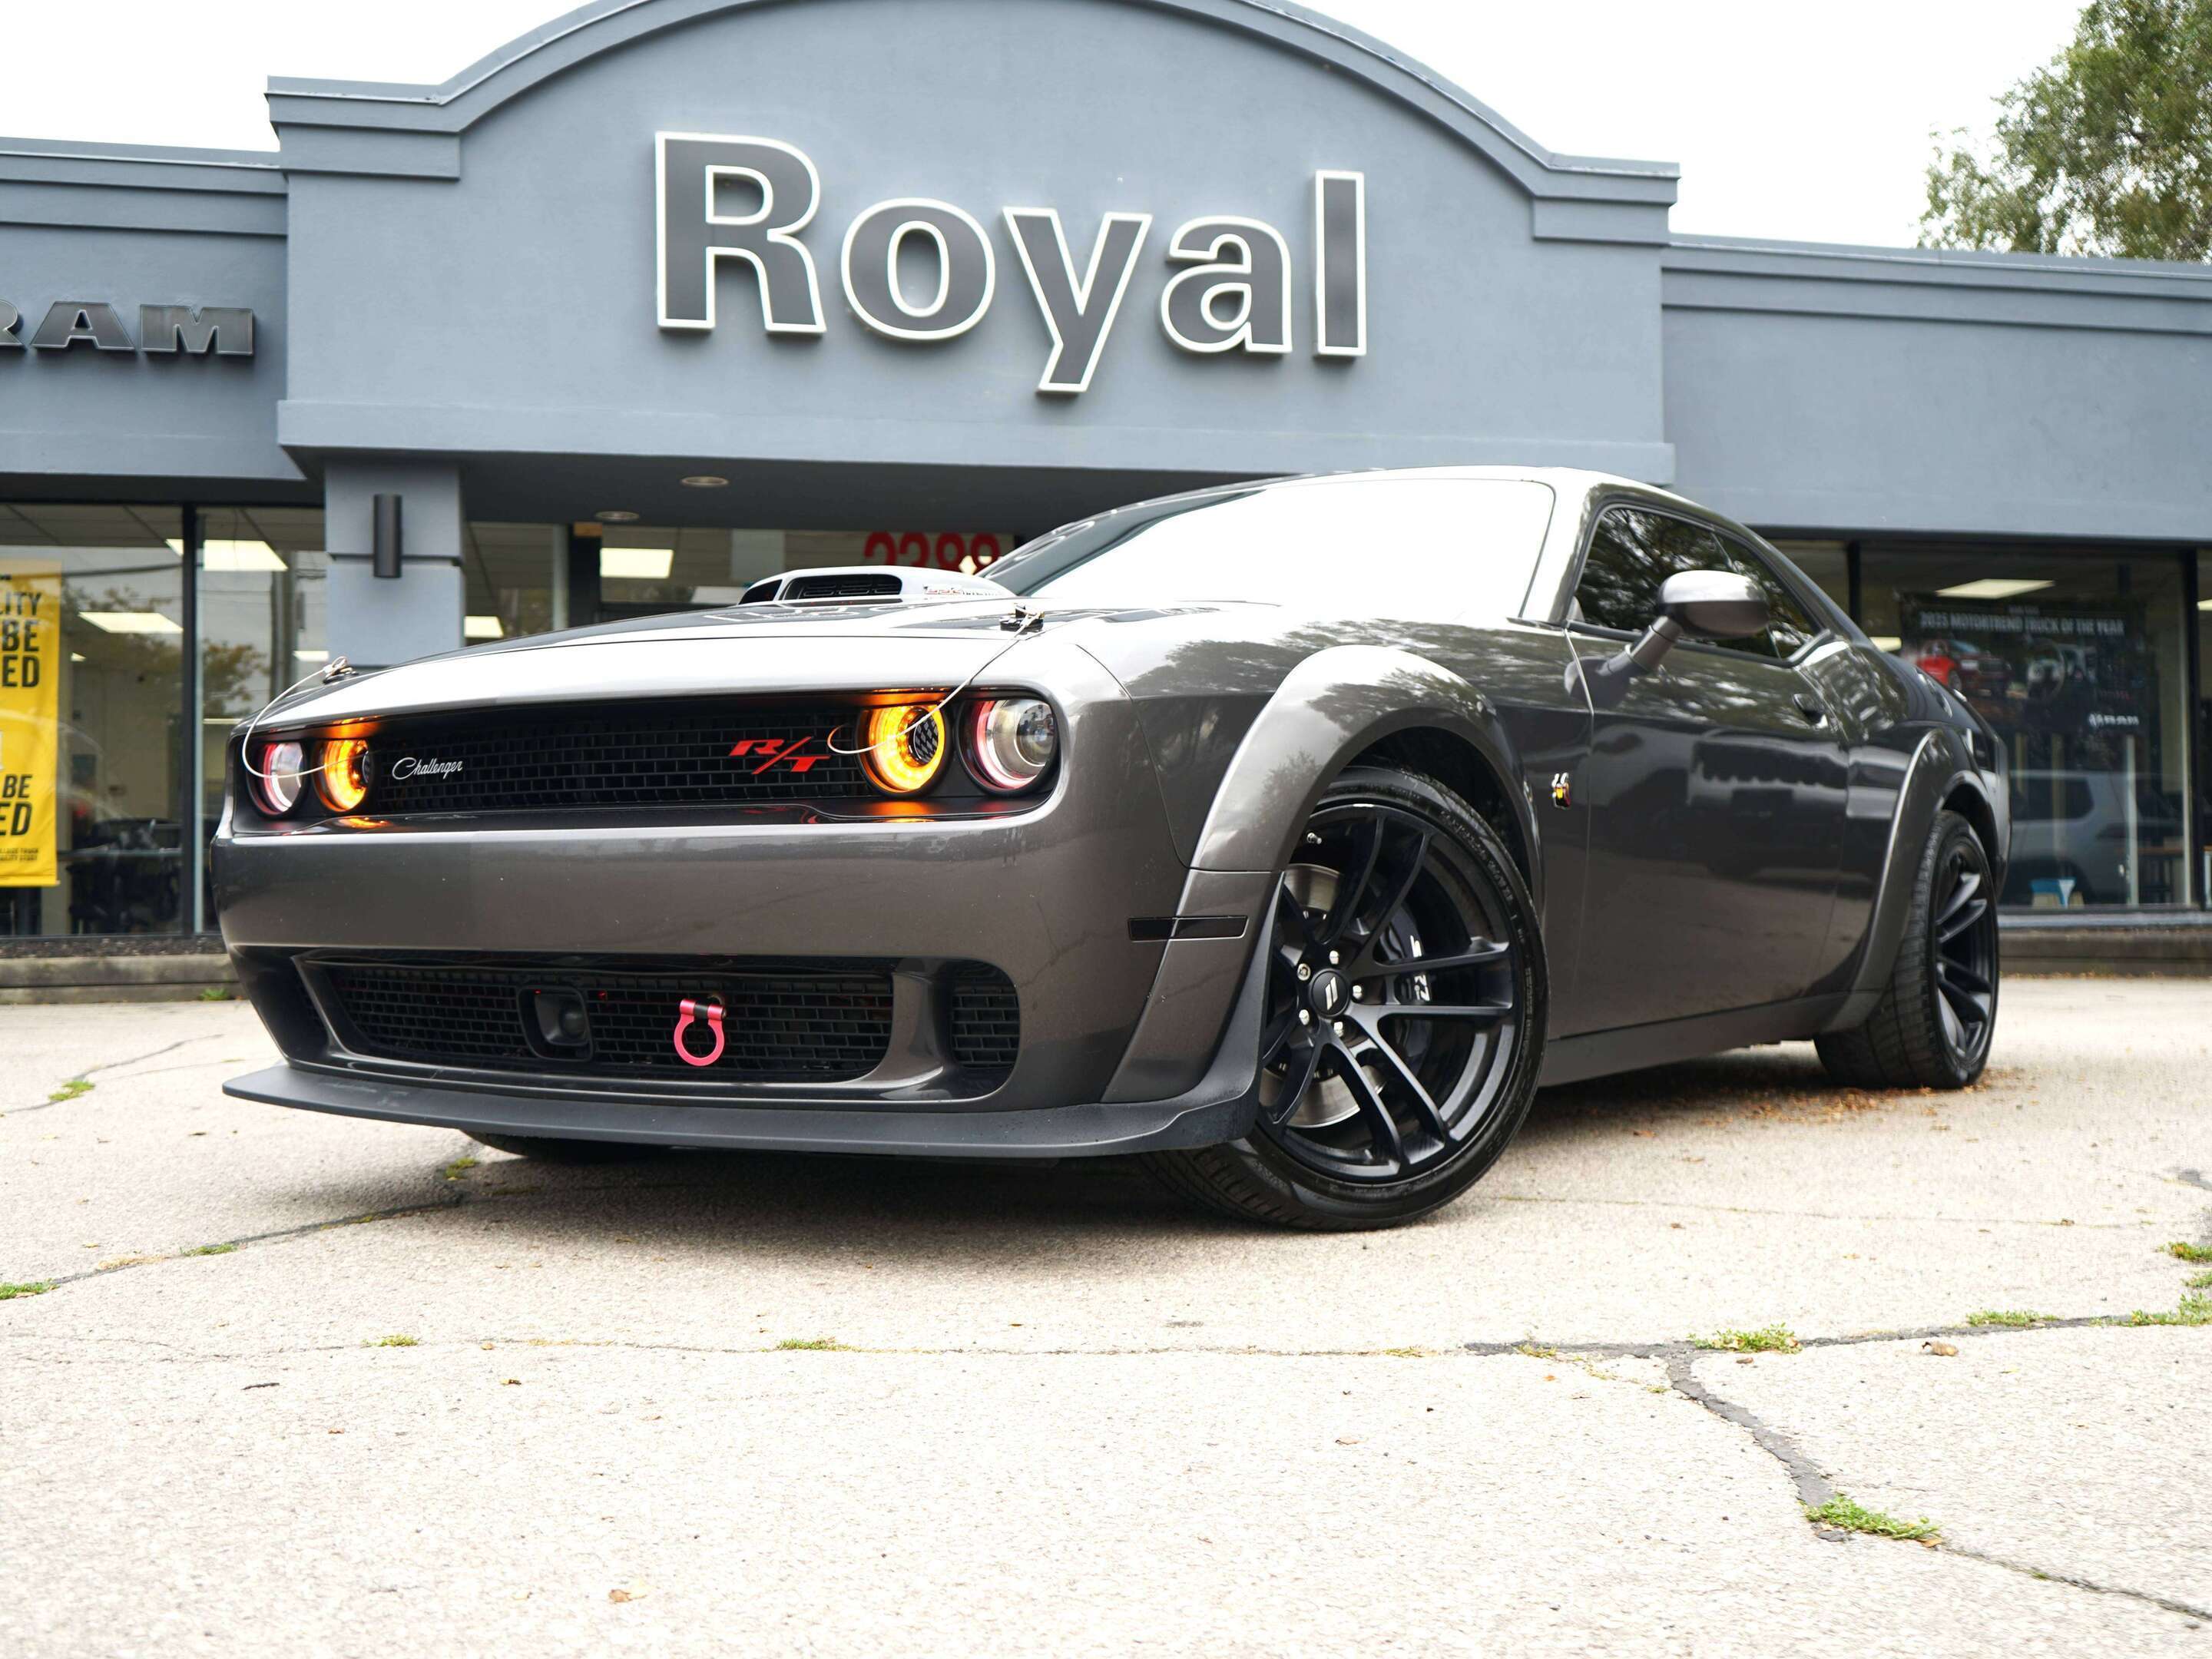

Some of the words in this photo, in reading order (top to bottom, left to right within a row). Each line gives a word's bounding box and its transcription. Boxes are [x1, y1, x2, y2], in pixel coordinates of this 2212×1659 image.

[655, 131, 1367, 393] Royal
[0, 298, 254, 356] AM
[0, 591, 41, 615] ITY
[2, 619, 39, 652] BE
[392, 757, 463, 780] Challenger
[729, 736, 831, 775] R/T
[2, 774, 32, 798] BE
